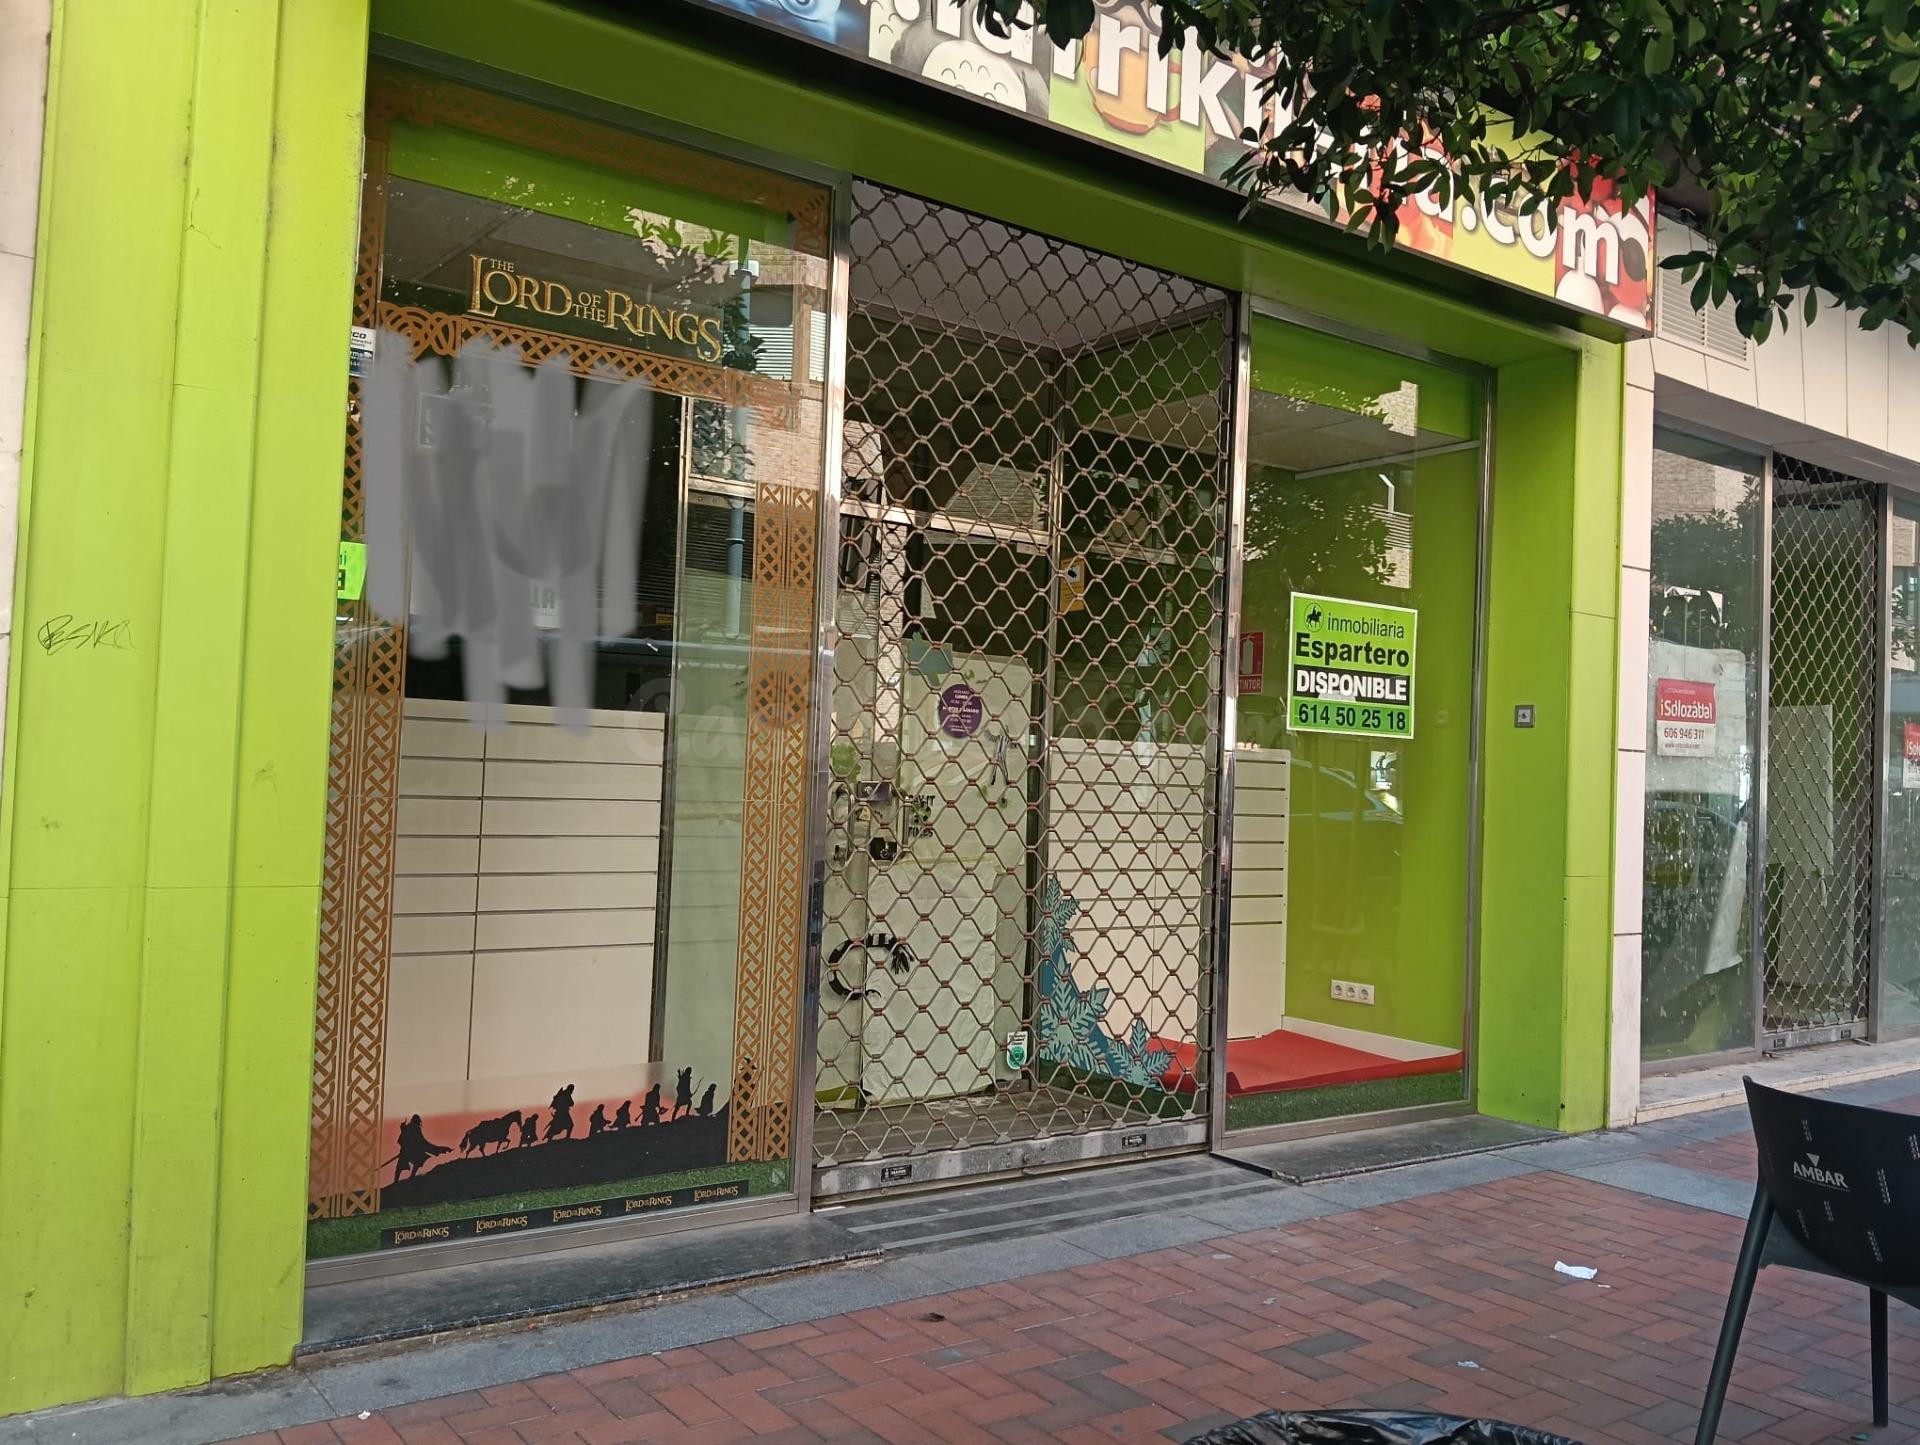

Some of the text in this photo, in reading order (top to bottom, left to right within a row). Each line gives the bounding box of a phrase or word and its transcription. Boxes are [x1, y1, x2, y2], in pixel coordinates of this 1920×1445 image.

[488, 258, 515, 273] THE
[467, 254, 601, 317] LORD OF
[572, 289, 722, 362] THE RINGS
[1327, 612, 1405, 639] inmobiliaria
[1295, 631, 1410, 668] Espartero
[1239, 679, 1261, 690] TINTOR
[1296, 669, 1407, 701] DISPONIBLE
[1298, 703, 1406, 731] 614 50 25 18
[1793, 1161, 1849, 1188] AMBAR
